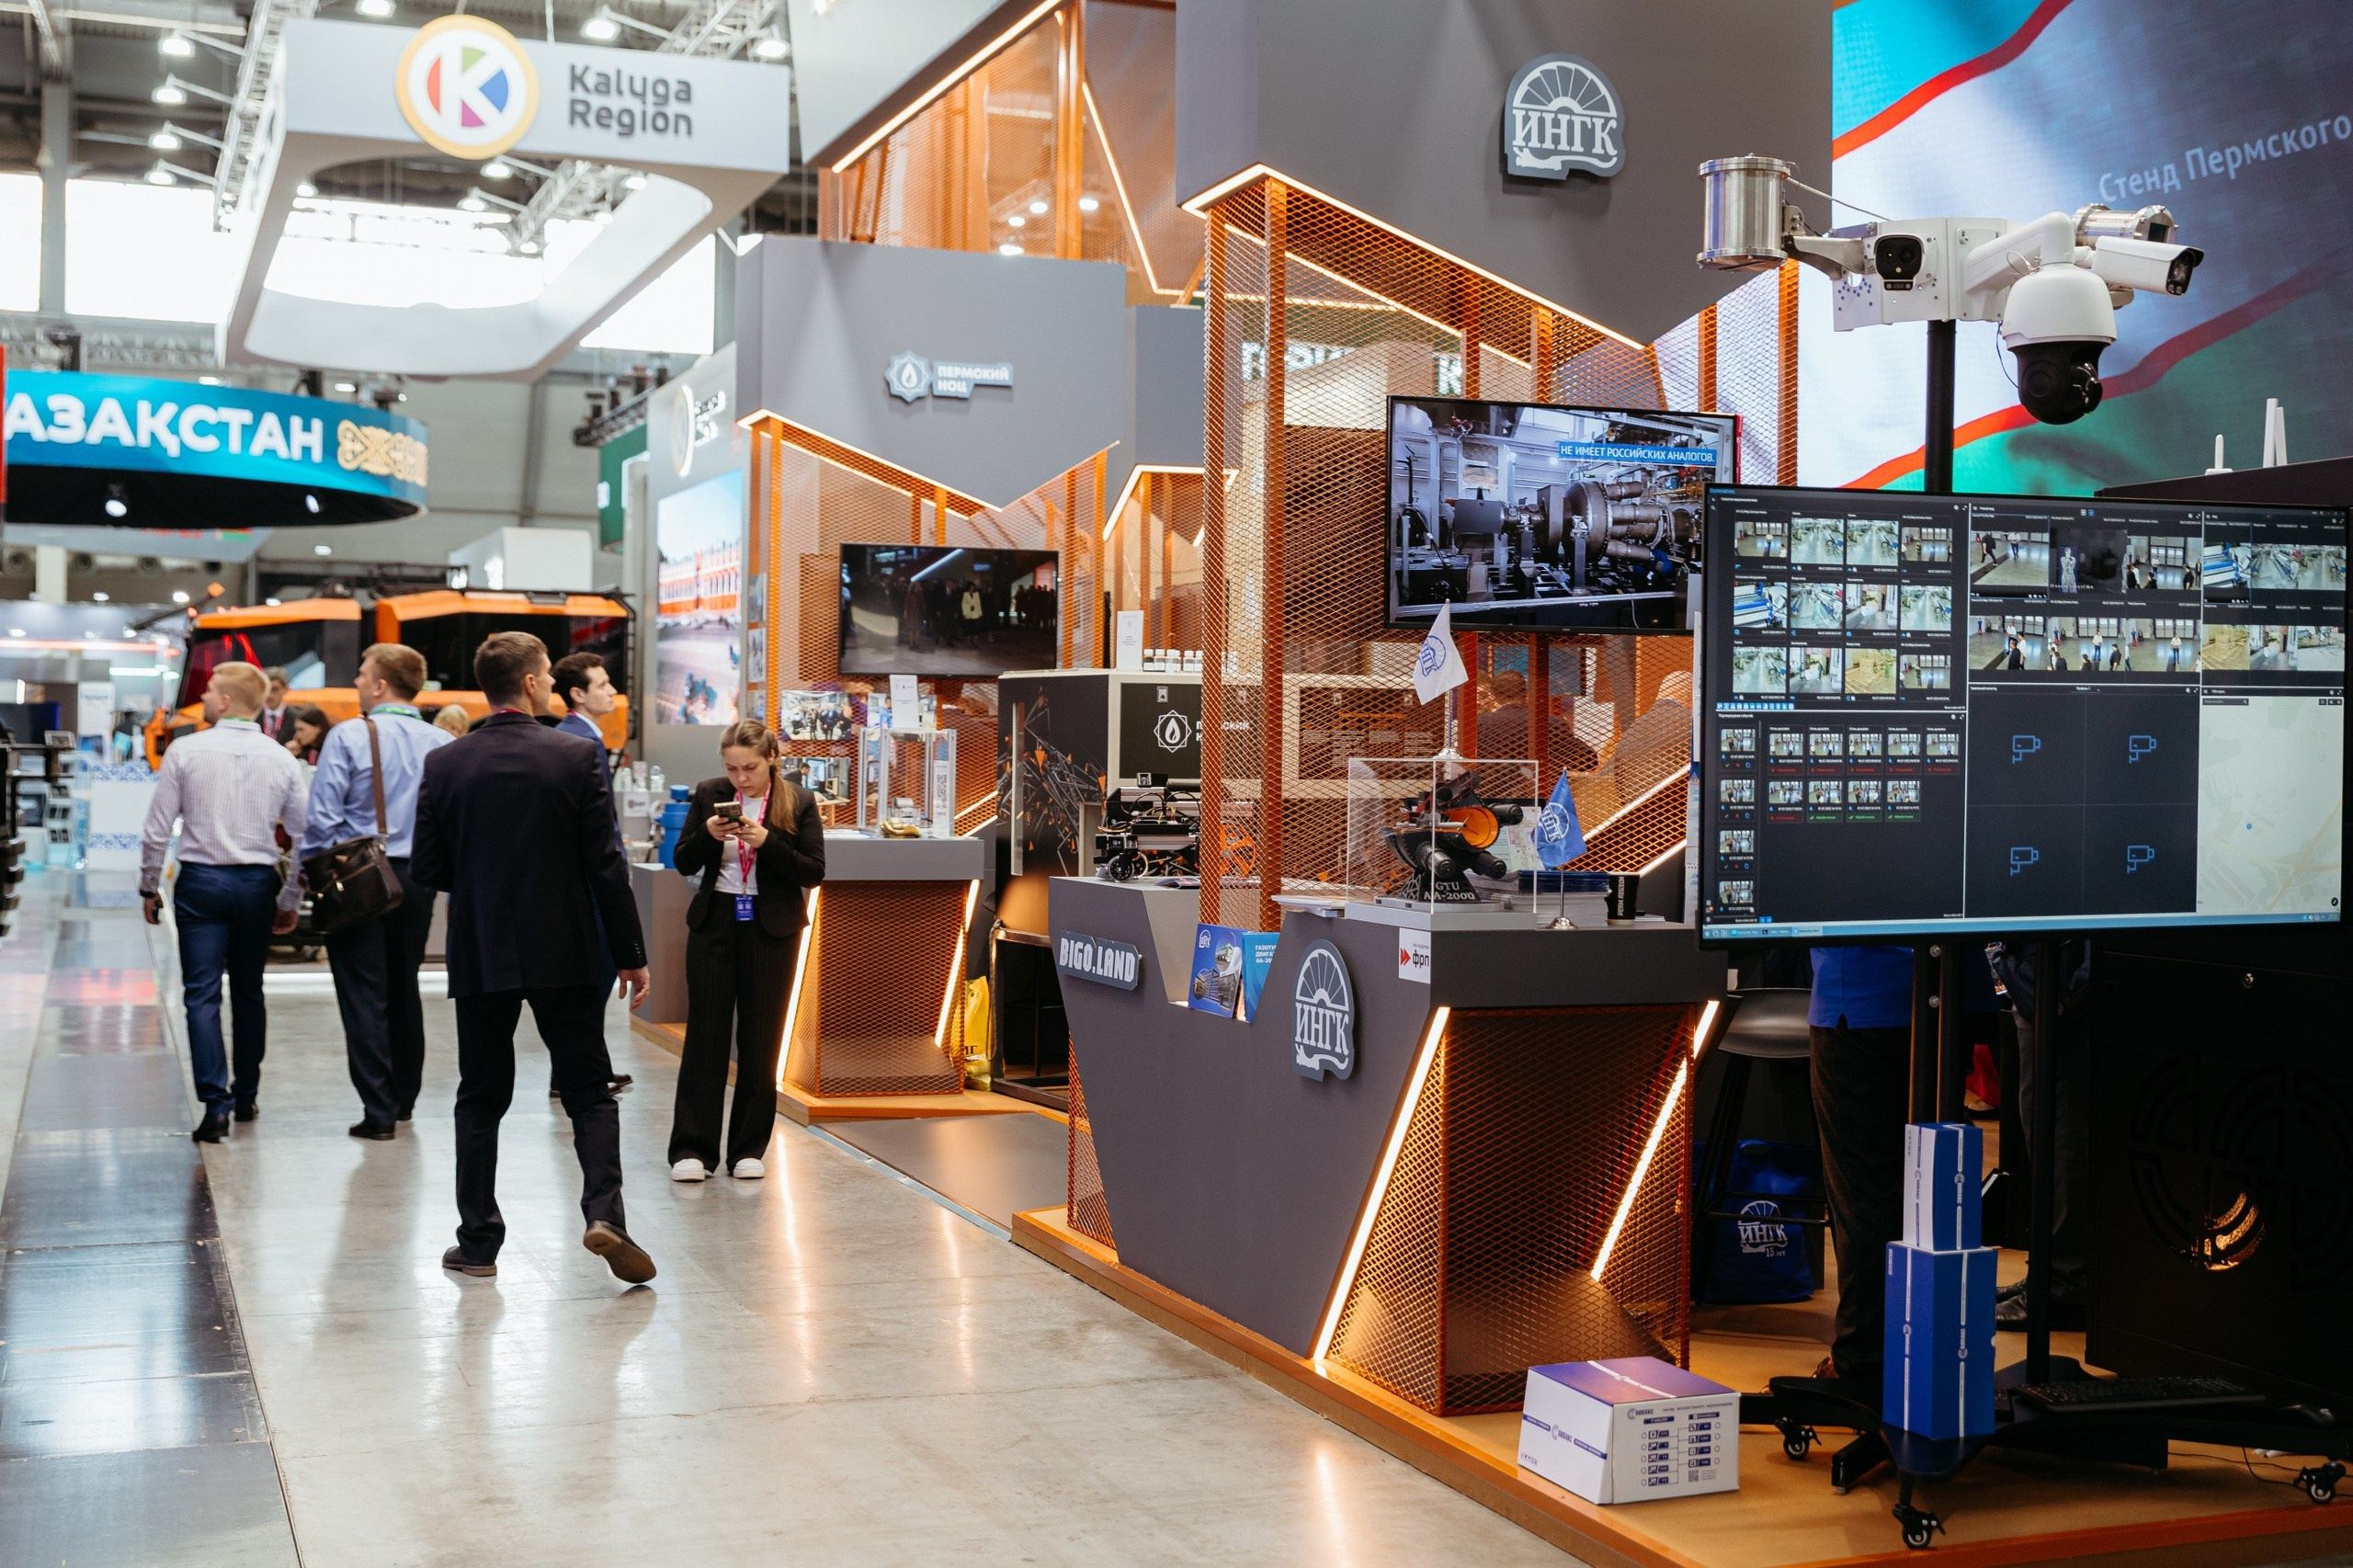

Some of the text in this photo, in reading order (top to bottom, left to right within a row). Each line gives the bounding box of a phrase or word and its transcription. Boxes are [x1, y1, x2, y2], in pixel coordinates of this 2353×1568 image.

[570, 98, 692, 136] Region
[1512, 108, 1618, 156] ИНГК
[2098, 115, 2352, 202] Стенд Пермского
[937, 365, 1010, 381] ПЕРМСКИЙ
[937, 379, 968, 392] НОЦ
[1561, 445, 1716, 463] НЕ ИМЕЕТ РОССИЙСКИХ АНАЛОГОВ.
[1435, 882, 1460, 891] GTU
[1059, 937, 1136, 983] BIGO.LAND
[1412, 949, 1429, 969] фрп
[1295, 1002, 1349, 1056] ИНГК
[1738, 1223, 1789, 1244] ИНГК
[1766, 1246, 1775, 1257] 15
